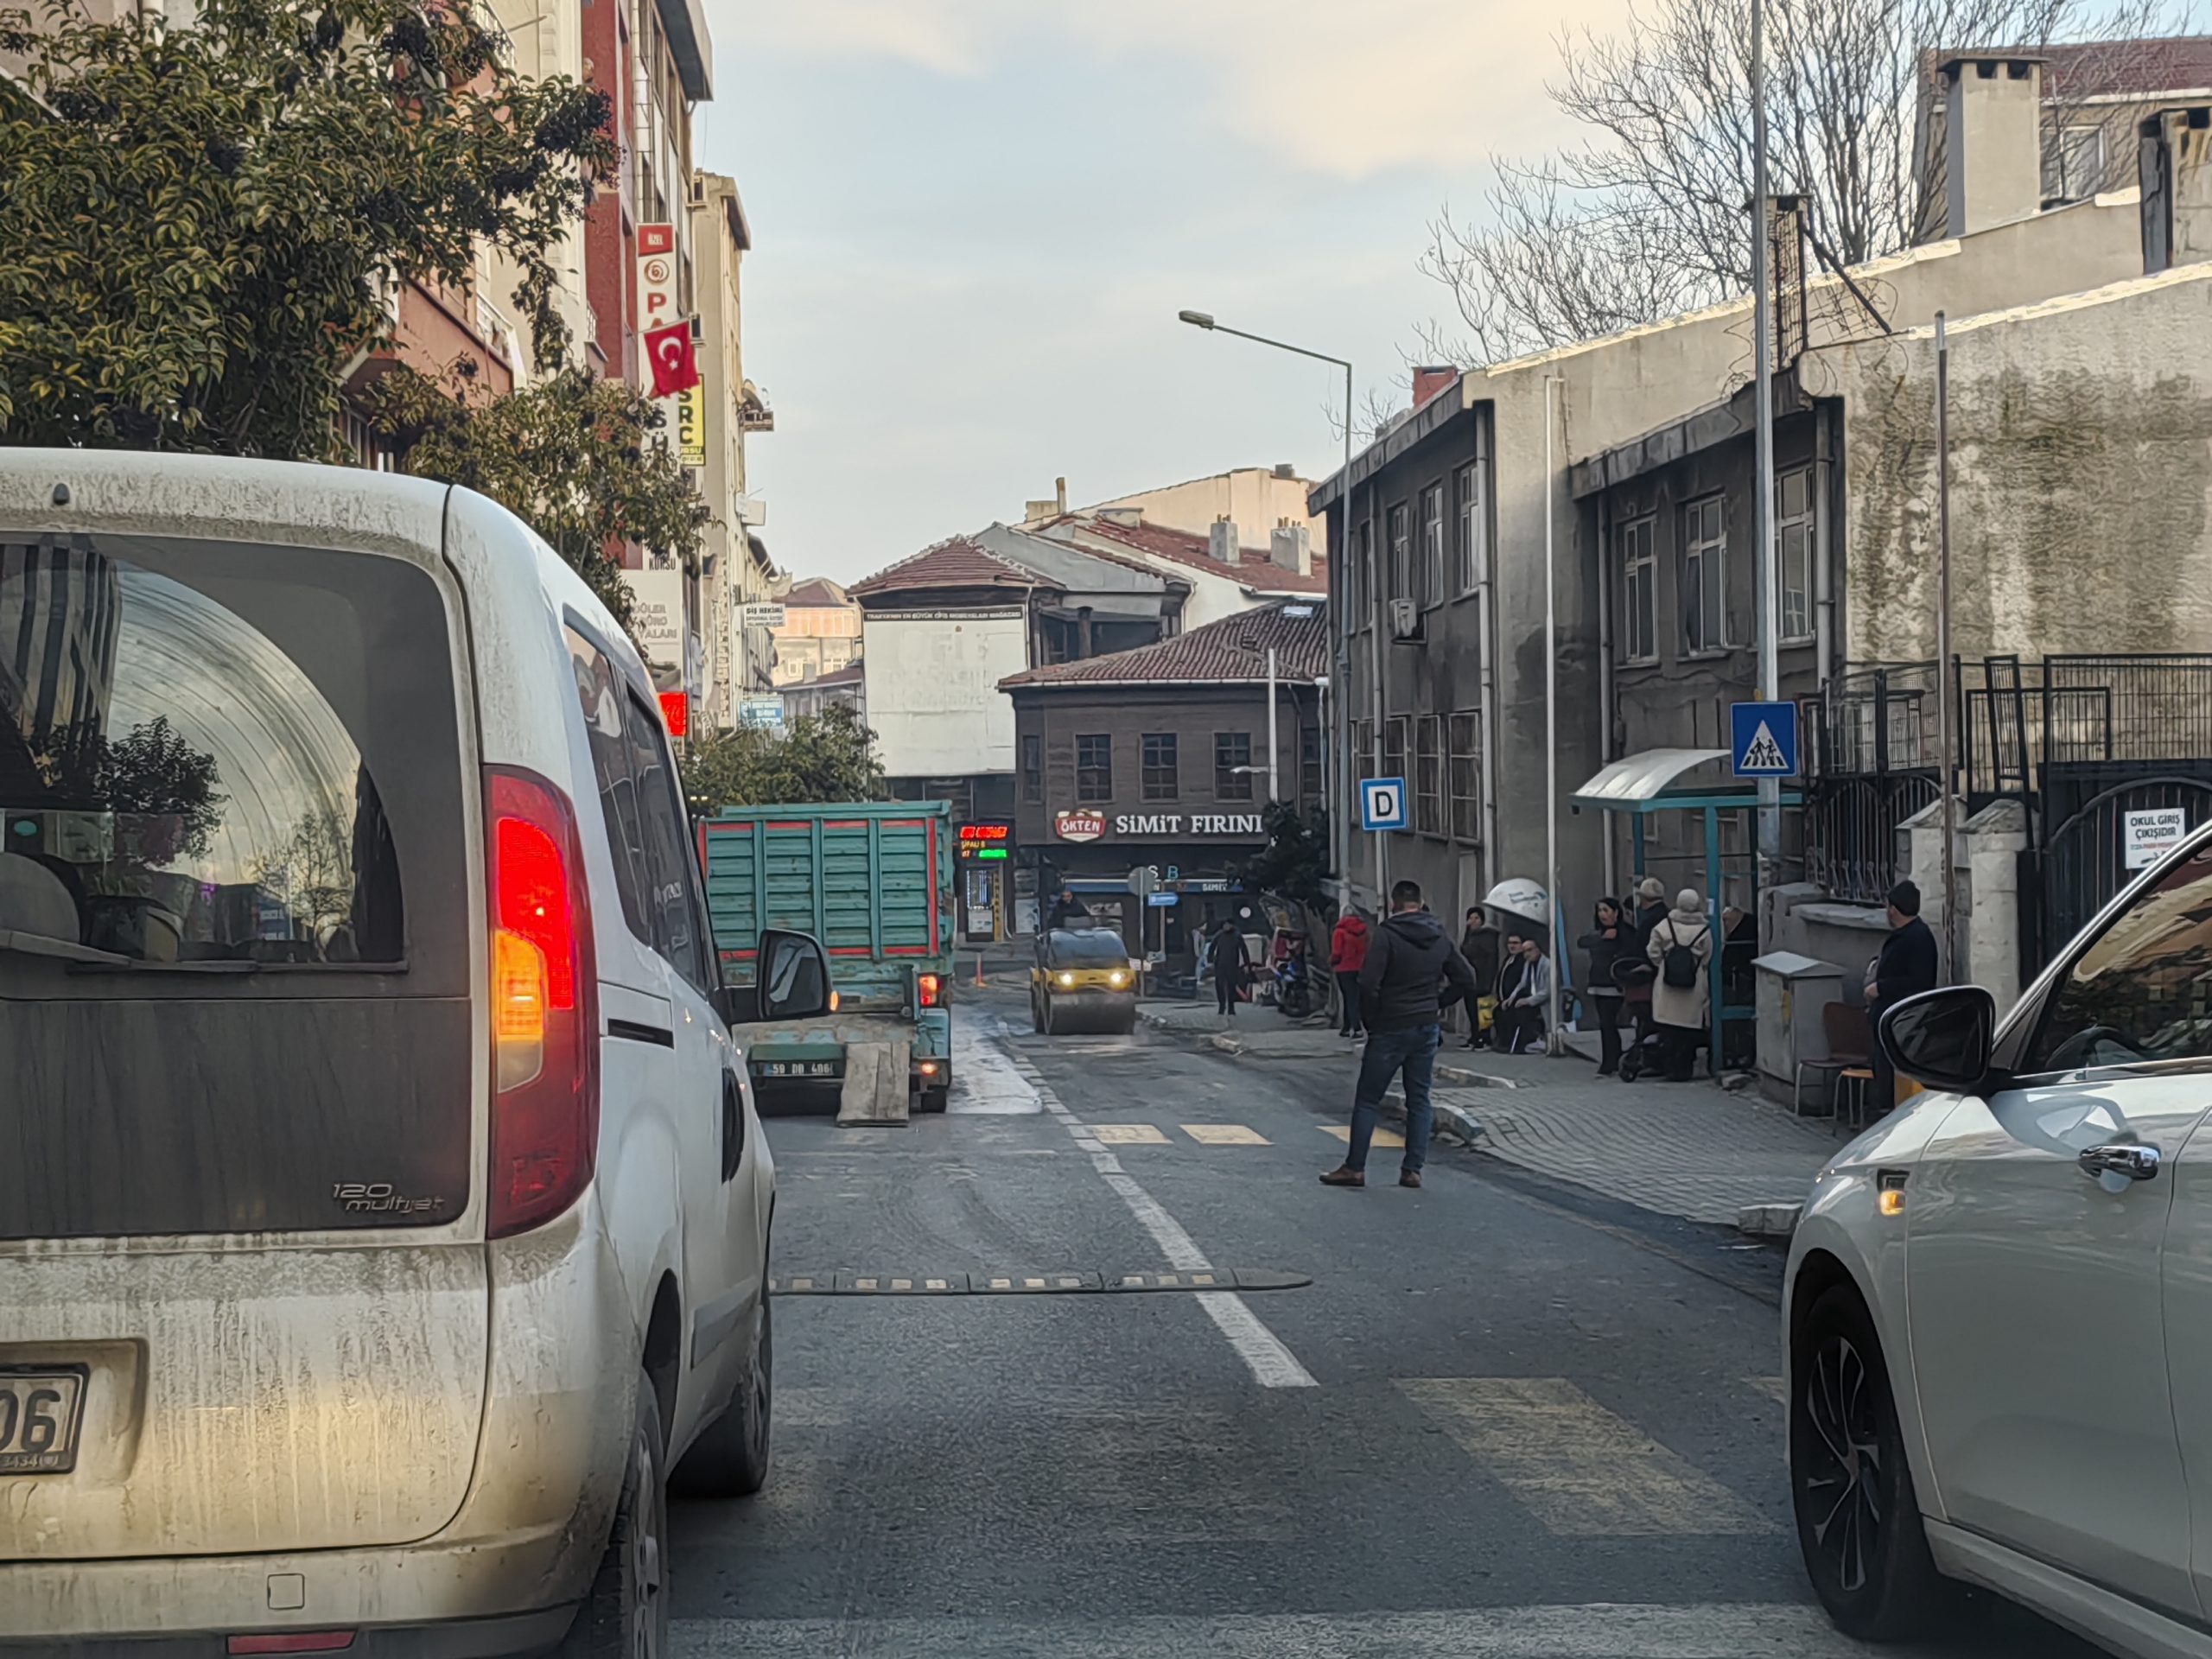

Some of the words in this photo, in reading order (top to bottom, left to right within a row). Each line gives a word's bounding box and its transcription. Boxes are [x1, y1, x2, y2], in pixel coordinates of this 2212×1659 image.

[1375, 791, 1393, 817] D
[1061, 817, 1101, 833] ÖKTEN
[1192, 814, 1263, 833] FIRINI
[2130, 817, 2156, 827] OKUL
[2158, 814, 2180, 825] GİRİŞ
[334, 1183, 393, 1198] 120
[346, 1195, 445, 1214] multijet
